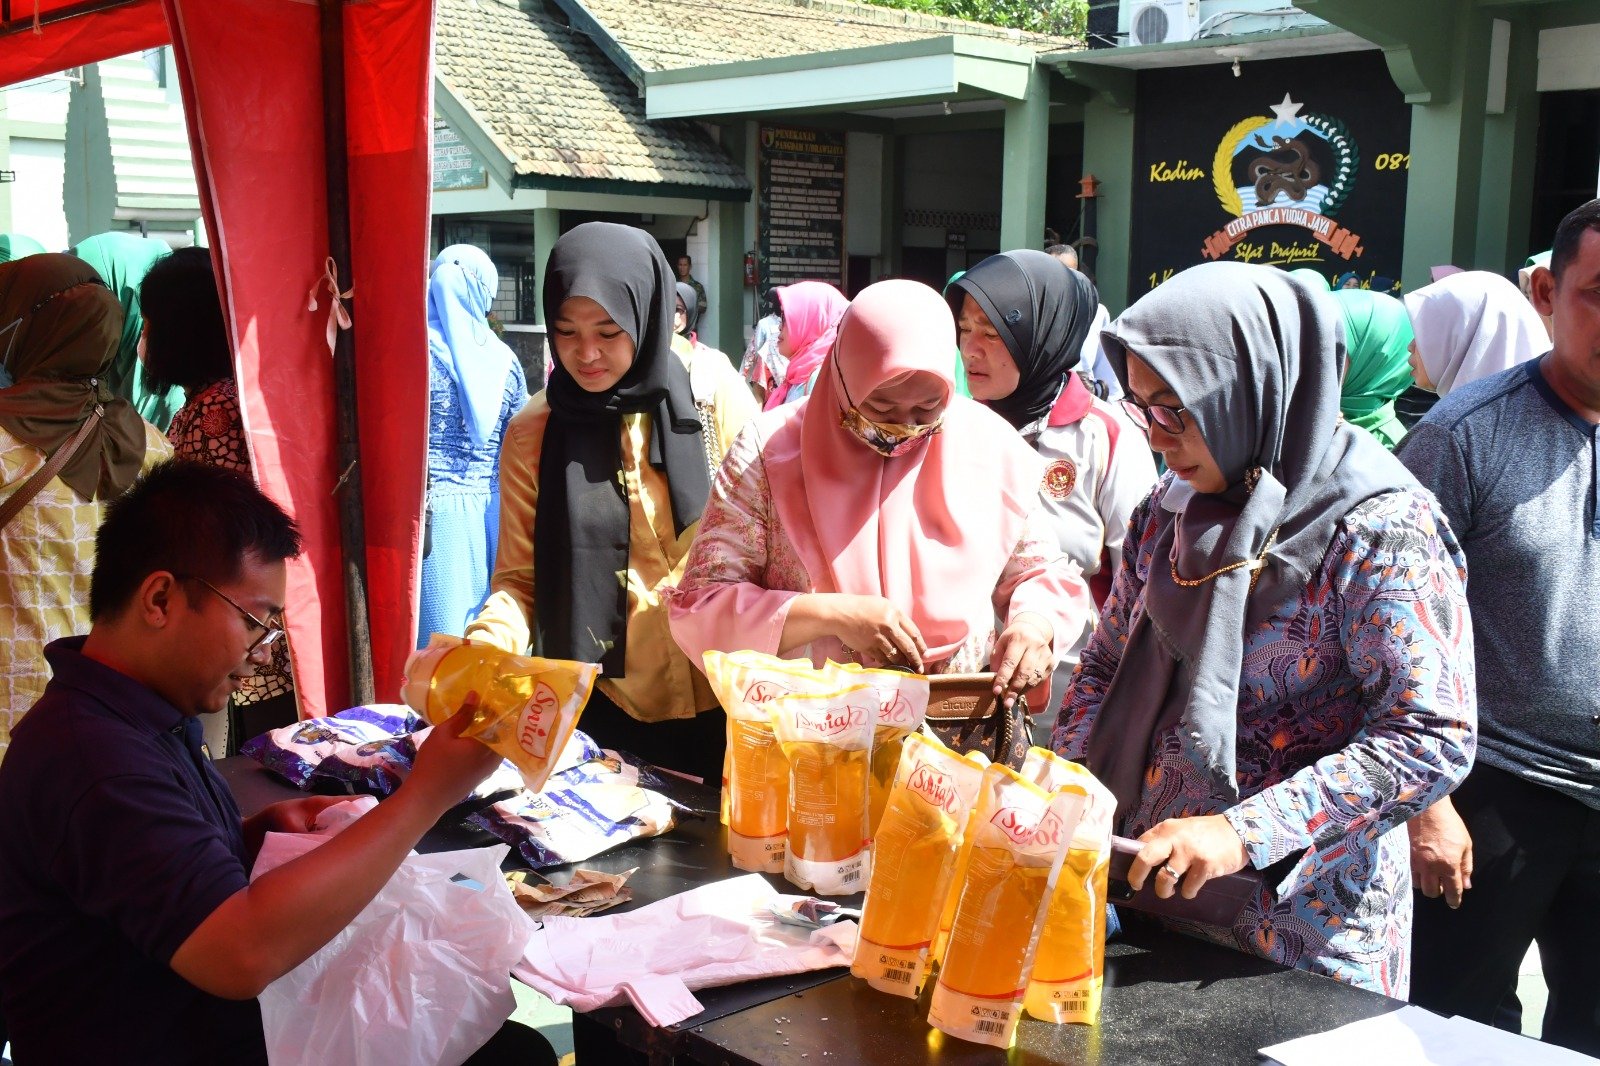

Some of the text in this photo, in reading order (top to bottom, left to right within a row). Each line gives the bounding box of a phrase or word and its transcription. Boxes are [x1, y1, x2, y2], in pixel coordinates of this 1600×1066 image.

[1150, 160, 1205, 182] Kodim
[1226, 208, 1330, 237] CITRA PANCA YUDHA JAYA
[1234, 241, 1320, 263] Sifat Prajurit
[521, 690, 556, 747] Sovia
